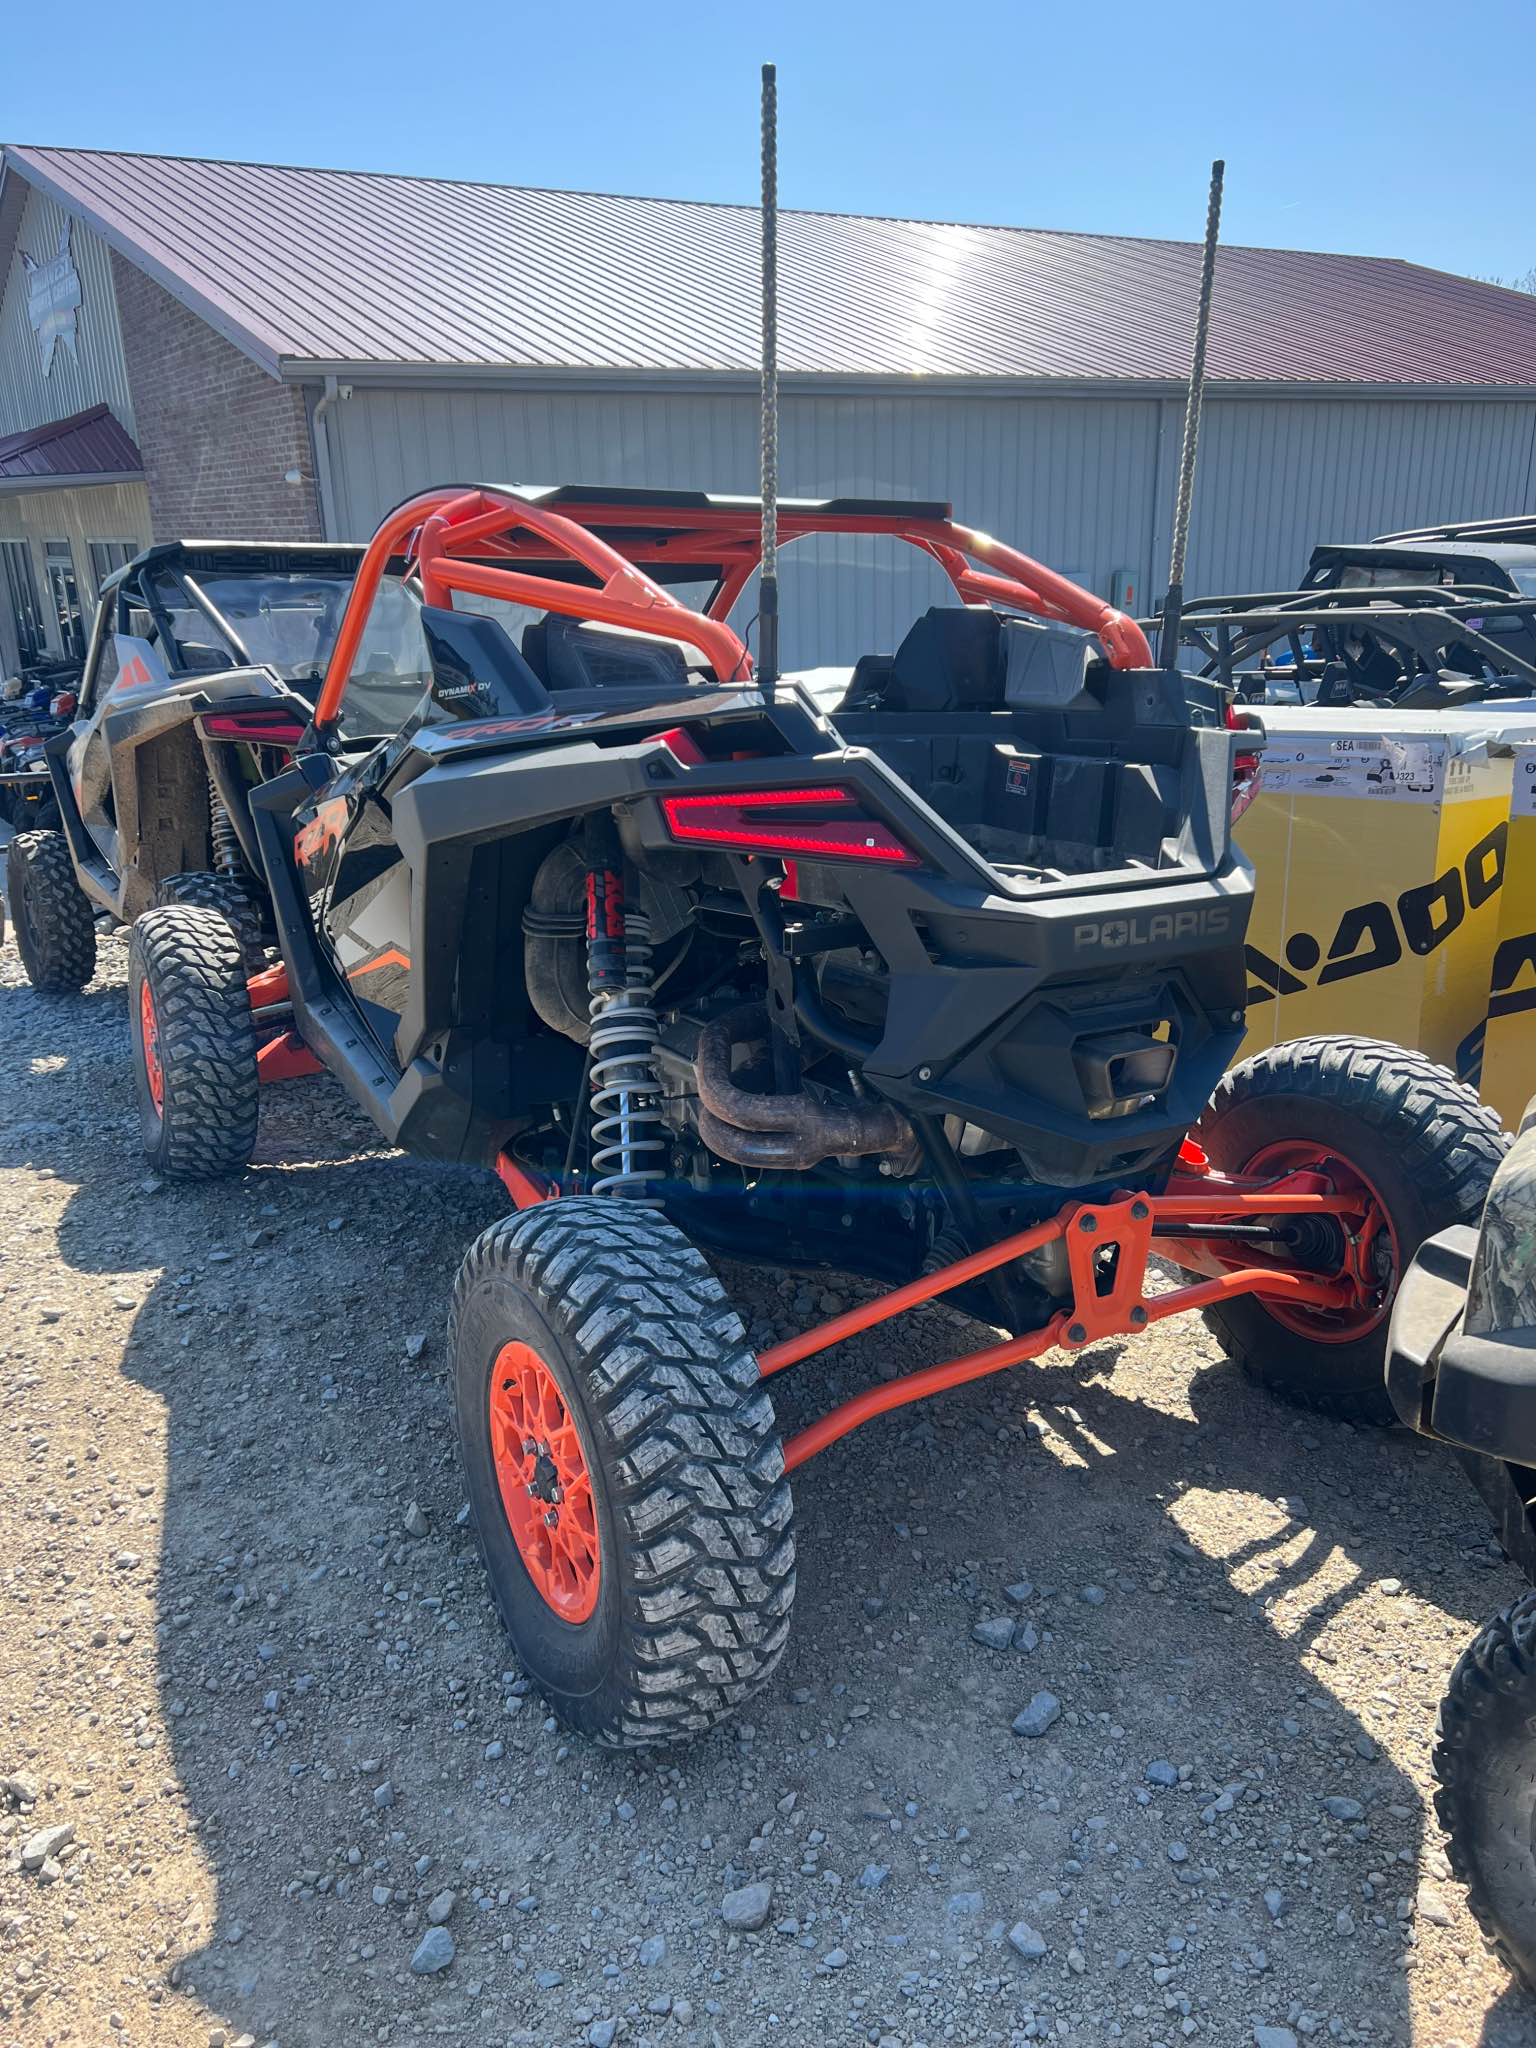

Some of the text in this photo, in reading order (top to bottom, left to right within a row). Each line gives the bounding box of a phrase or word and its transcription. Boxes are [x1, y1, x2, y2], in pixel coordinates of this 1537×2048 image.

[438, 681, 492, 698] DYNAMIX DV
[1336, 740, 1354, 750] SEA
[1074, 906, 1230, 949] POLARIS
